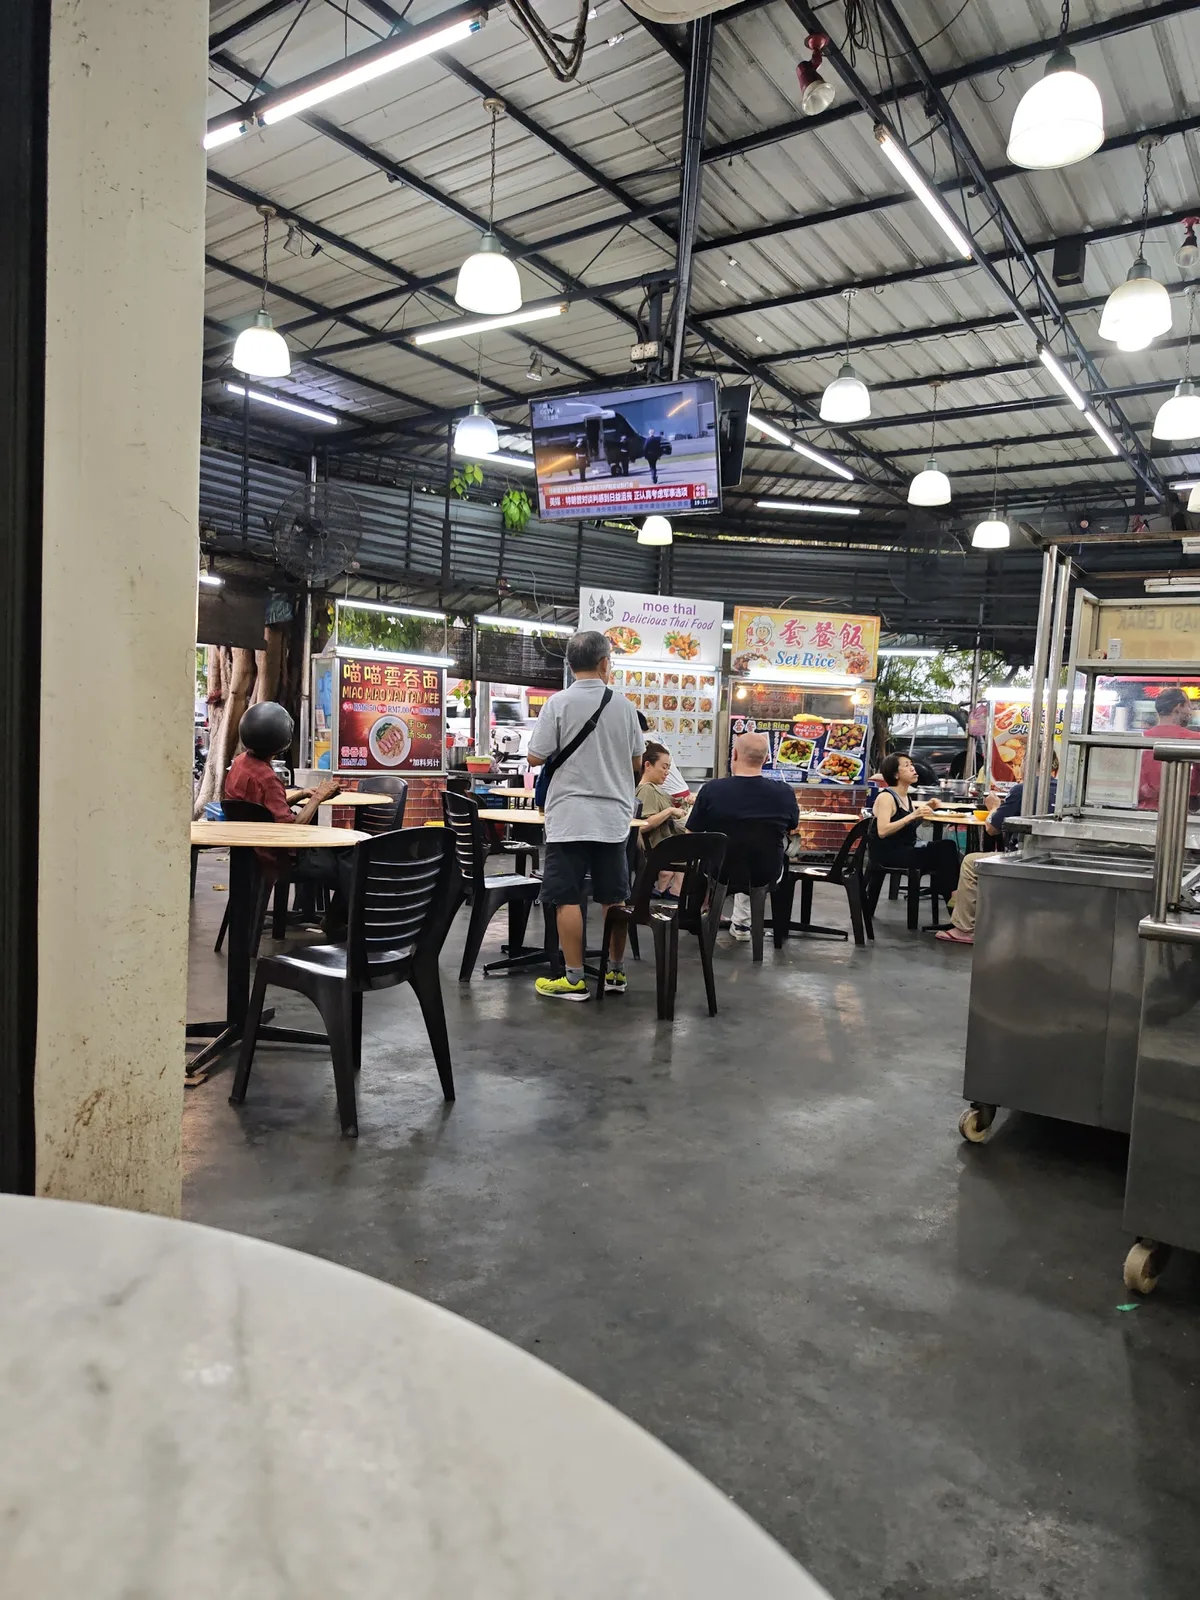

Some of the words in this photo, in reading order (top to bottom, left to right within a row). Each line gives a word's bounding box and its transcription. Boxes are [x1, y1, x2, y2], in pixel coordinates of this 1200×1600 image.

[642, 602, 669, 613] moe
[622, 611, 667, 627] Delicious
[669, 616, 690, 628] Thai
[690, 618, 716, 630] Food
[775, 651, 799, 667] Set
[801, 652, 836, 668] Rice
[343, 663, 439, 689] 喵喵雲吞面
[342, 686, 363, 699] MIAO
[365, 687, 387, 701] MIAO
[387, 688, 406, 703] WAN
[406, 690, 422, 704] TAN
[423, 691, 440, 705] MEE
[416, 721, 428, 730] Dry
[757, 721, 771, 730] Set
[773, 722, 790, 731] Rice
[416, 731, 432, 740] Soup
